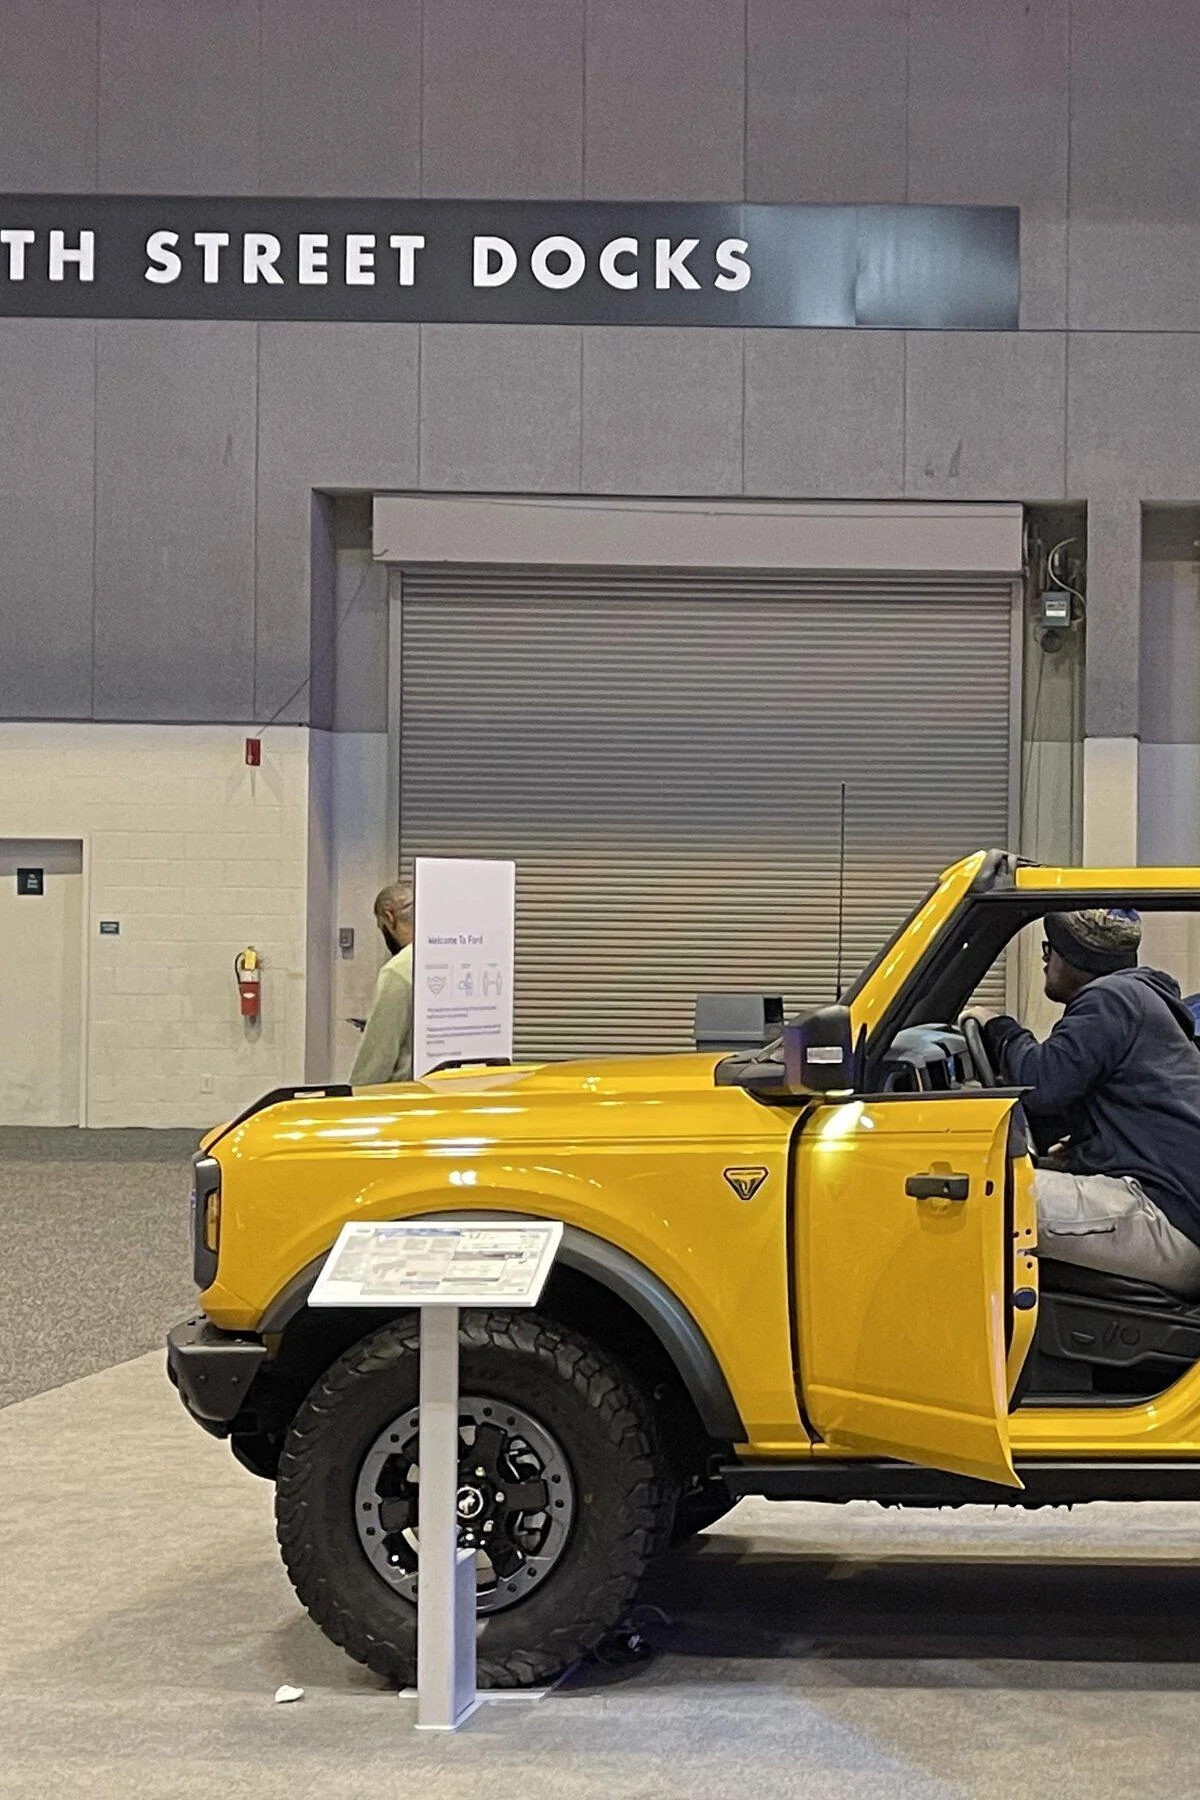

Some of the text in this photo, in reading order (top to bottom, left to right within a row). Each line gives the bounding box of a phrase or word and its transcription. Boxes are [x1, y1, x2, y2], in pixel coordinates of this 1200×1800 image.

[0, 229, 751, 292] TH STREET DOCKS
[428, 934, 483, 945] Welcome To Ford
